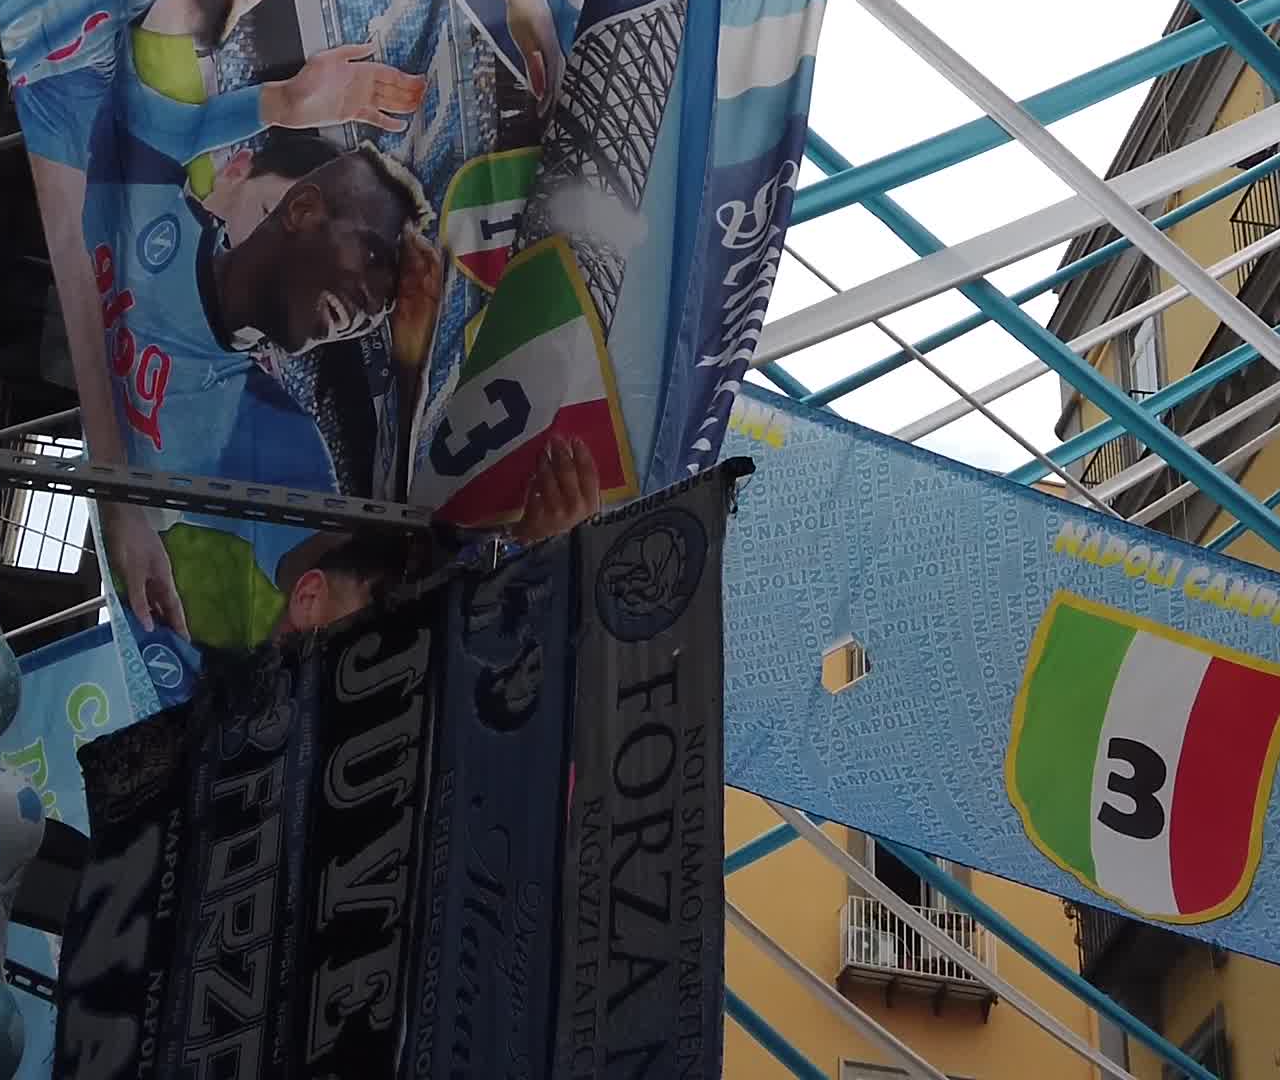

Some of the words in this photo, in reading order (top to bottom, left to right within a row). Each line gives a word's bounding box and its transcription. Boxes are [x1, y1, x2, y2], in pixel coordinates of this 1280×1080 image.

[430, 379, 531, 476] 3
[1055, 519, 1182, 589] NAPOLI
[680, 721, 706, 794] NOI
[1097, 737, 1167, 841] 3
[154, 806, 185, 921] NAPOLI
[306, 626, 432, 1063] JUVE
[577, 797, 605, 947] RAGAZZI
[605, 656, 681, 1018] FORZA
[679, 805, 705, 923] SIAMO
